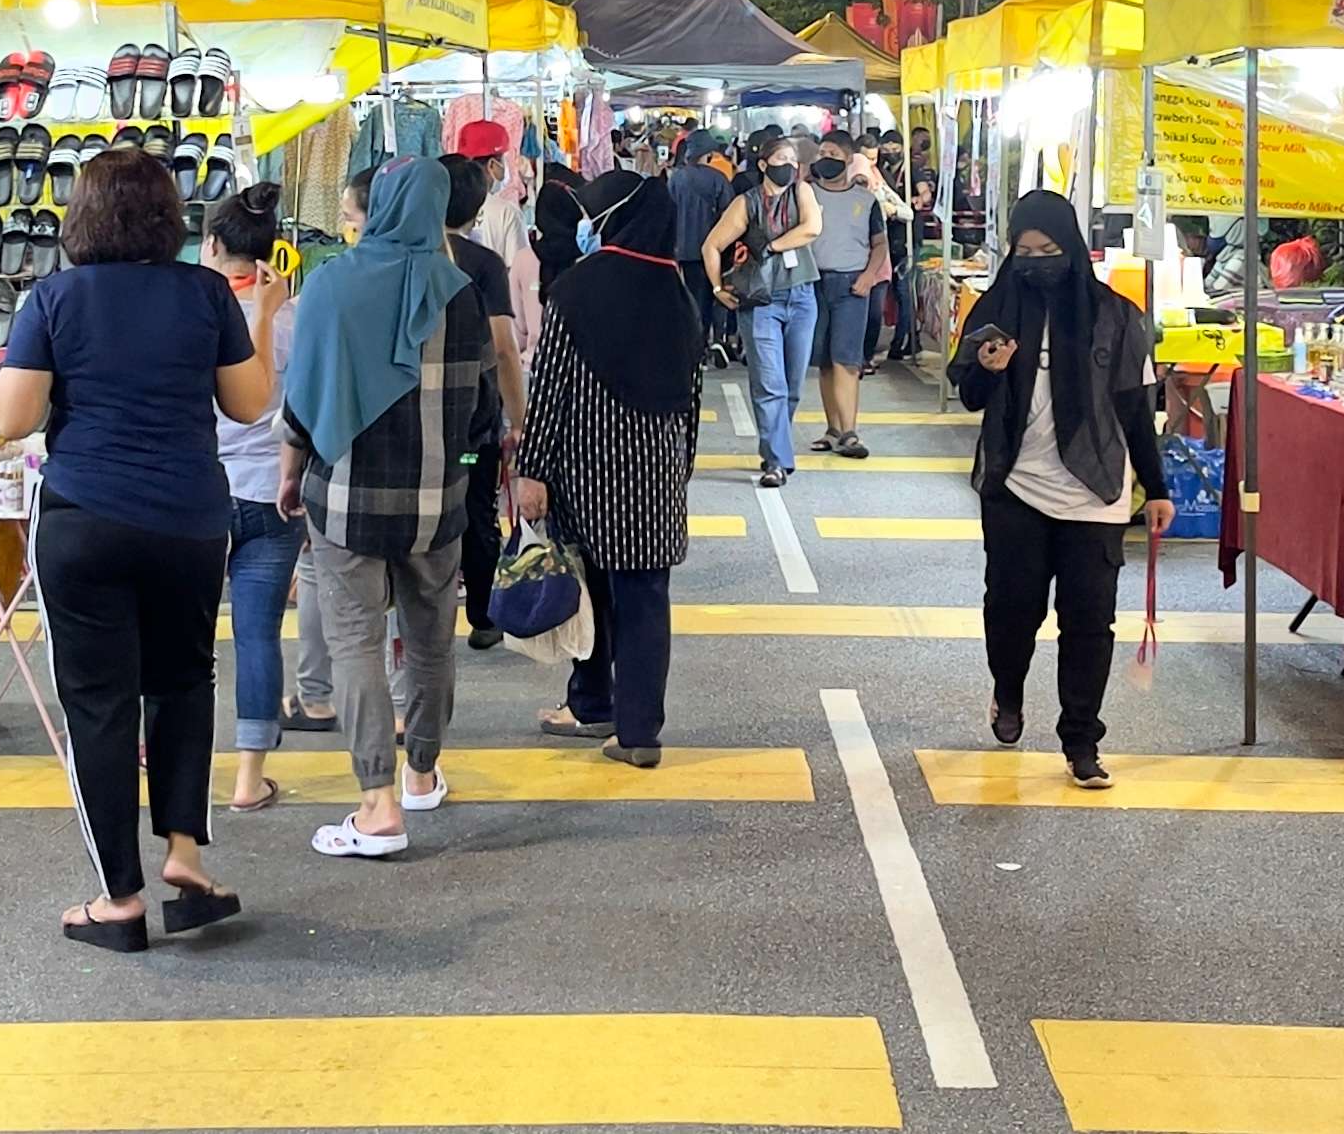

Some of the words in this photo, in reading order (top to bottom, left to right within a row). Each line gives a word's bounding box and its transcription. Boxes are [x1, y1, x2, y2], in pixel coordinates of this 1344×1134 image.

[1191, 134, 1217, 145] Susu
[1283, 143, 1307, 154] Milk
[1179, 153, 1205, 164] Susu
[1209, 155, 1236, 166] Corn
[1177, 173, 1203, 184] Susu
[1207, 175, 1246, 186] Banan
[1259, 198, 1306, 211] Avocado
